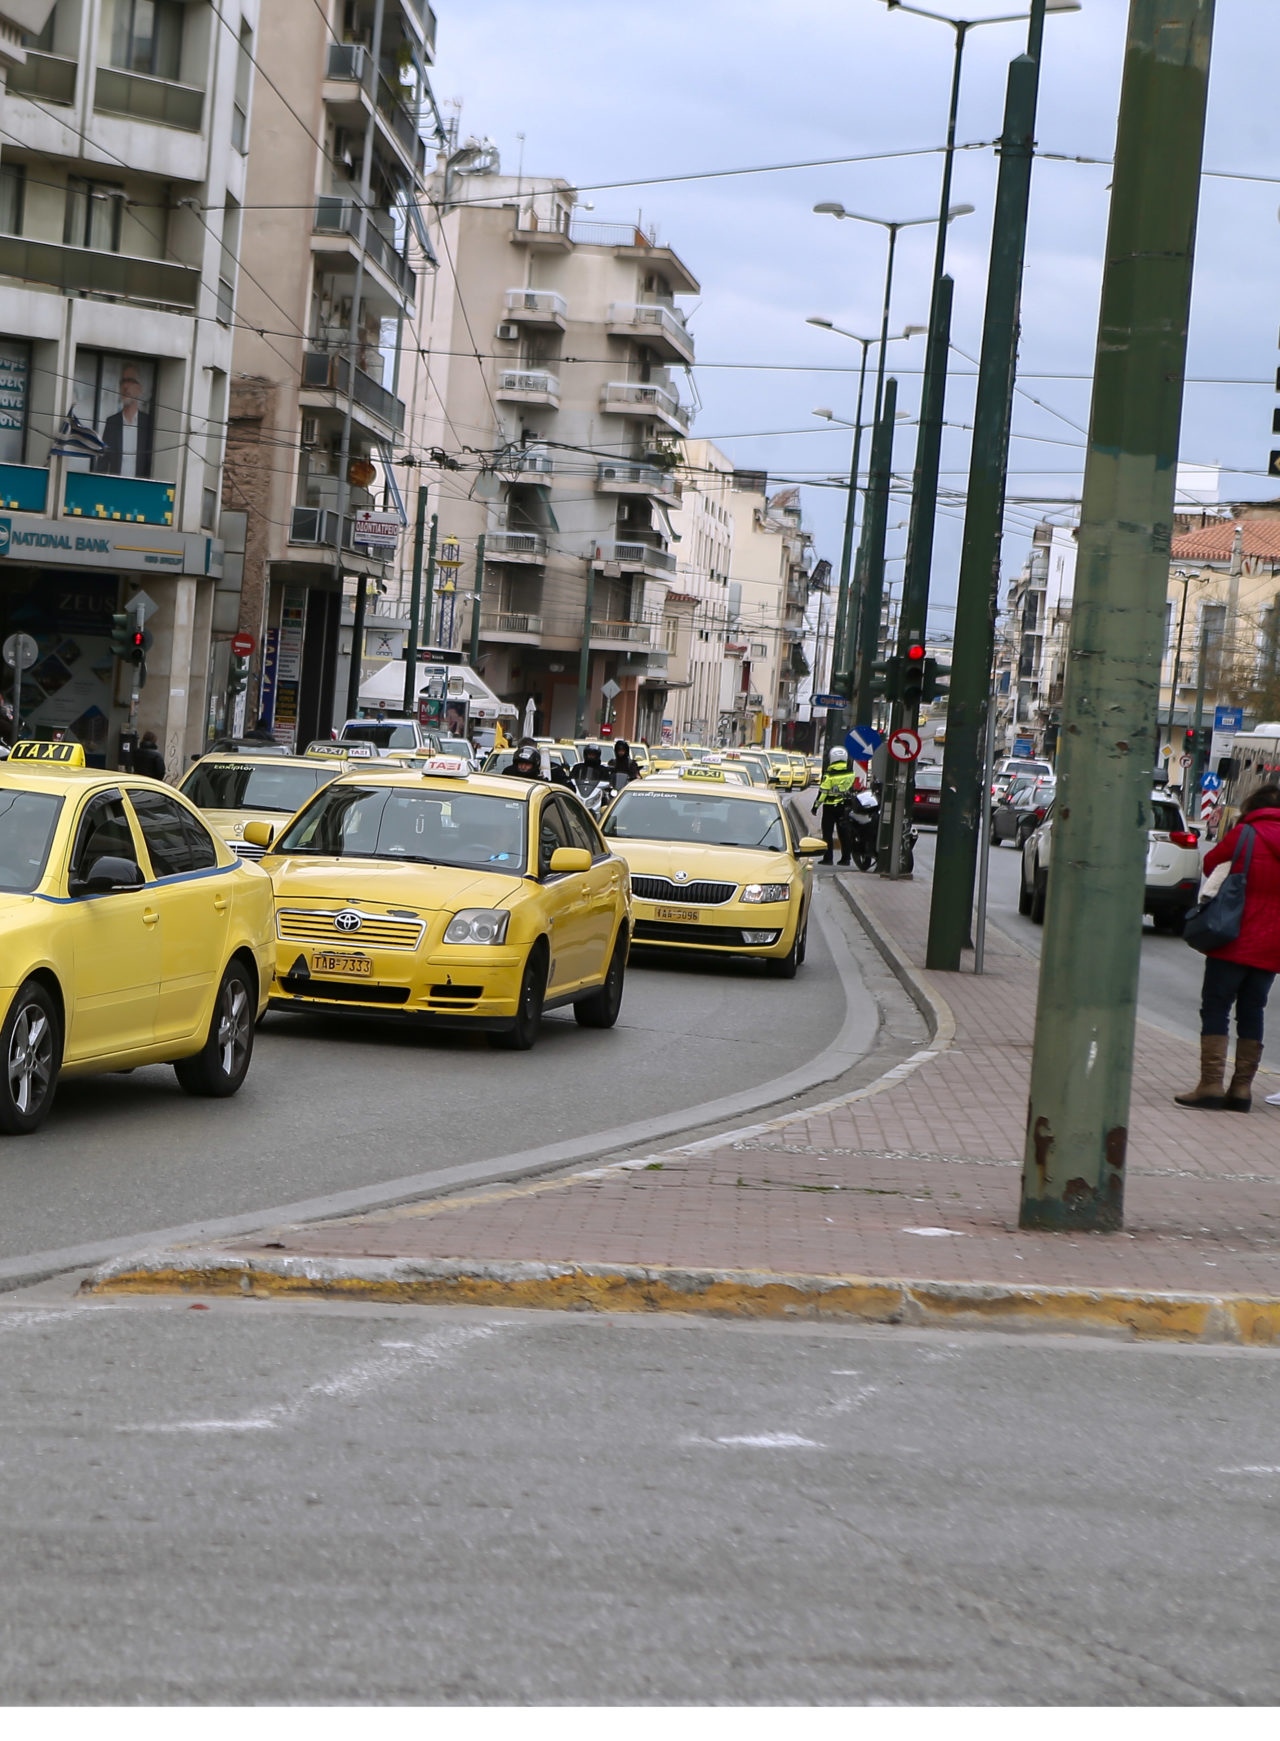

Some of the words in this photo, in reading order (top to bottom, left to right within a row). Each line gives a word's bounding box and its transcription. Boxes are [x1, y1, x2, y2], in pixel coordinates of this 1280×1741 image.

[11, 531, 72, 549] NATIONAL
[75, 537, 110, 553] BANK
[58, 593, 114, 613] ZEUS
[17, 743, 69, 759] TAXI
[314, 747, 344, 756] TAXI
[689, 769, 720, 778] TAXI
